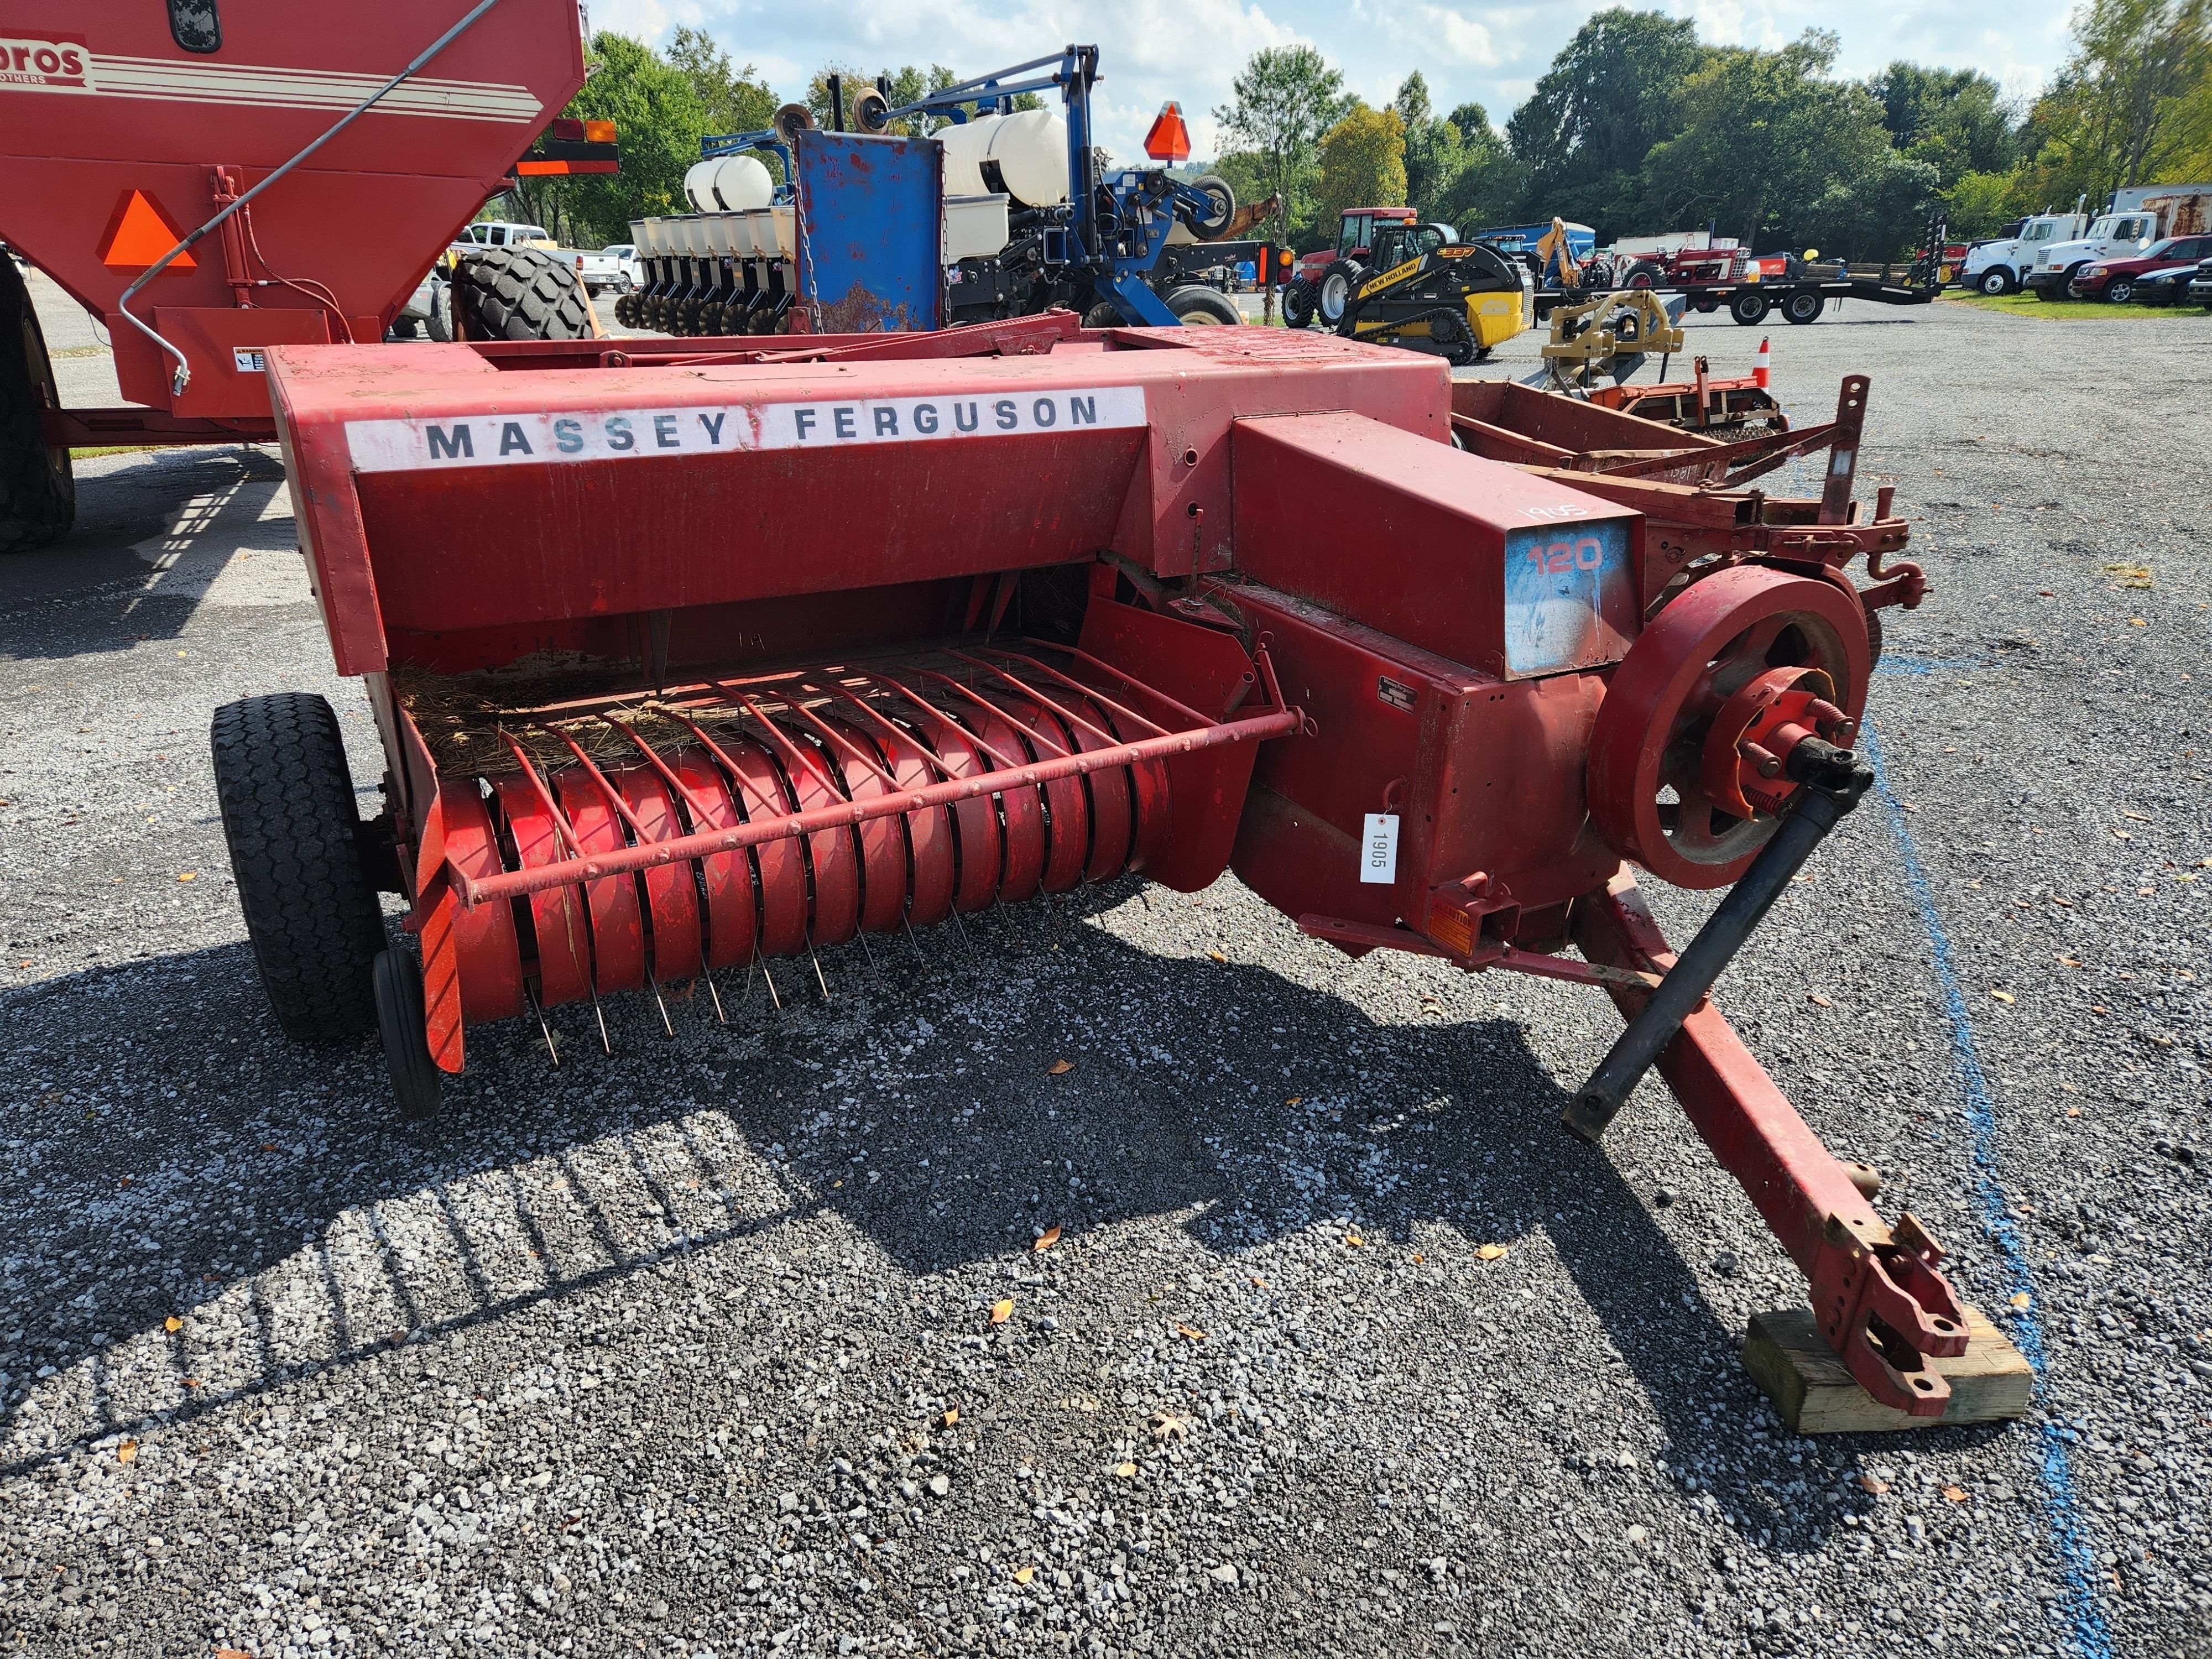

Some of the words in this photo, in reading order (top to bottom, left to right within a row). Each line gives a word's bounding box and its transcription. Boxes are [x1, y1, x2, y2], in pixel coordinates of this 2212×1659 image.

[1369, 278, 1384, 290] NEW
[1385, 263, 1416, 282] HOLLAND
[426, 413, 726, 460] MASSEY
[795, 396, 1097, 440] FERGUSON
[1517, 504, 1588, 521] 1905
[1527, 538, 1603, 576] 120
[1371, 833, 1389, 868] 1905
